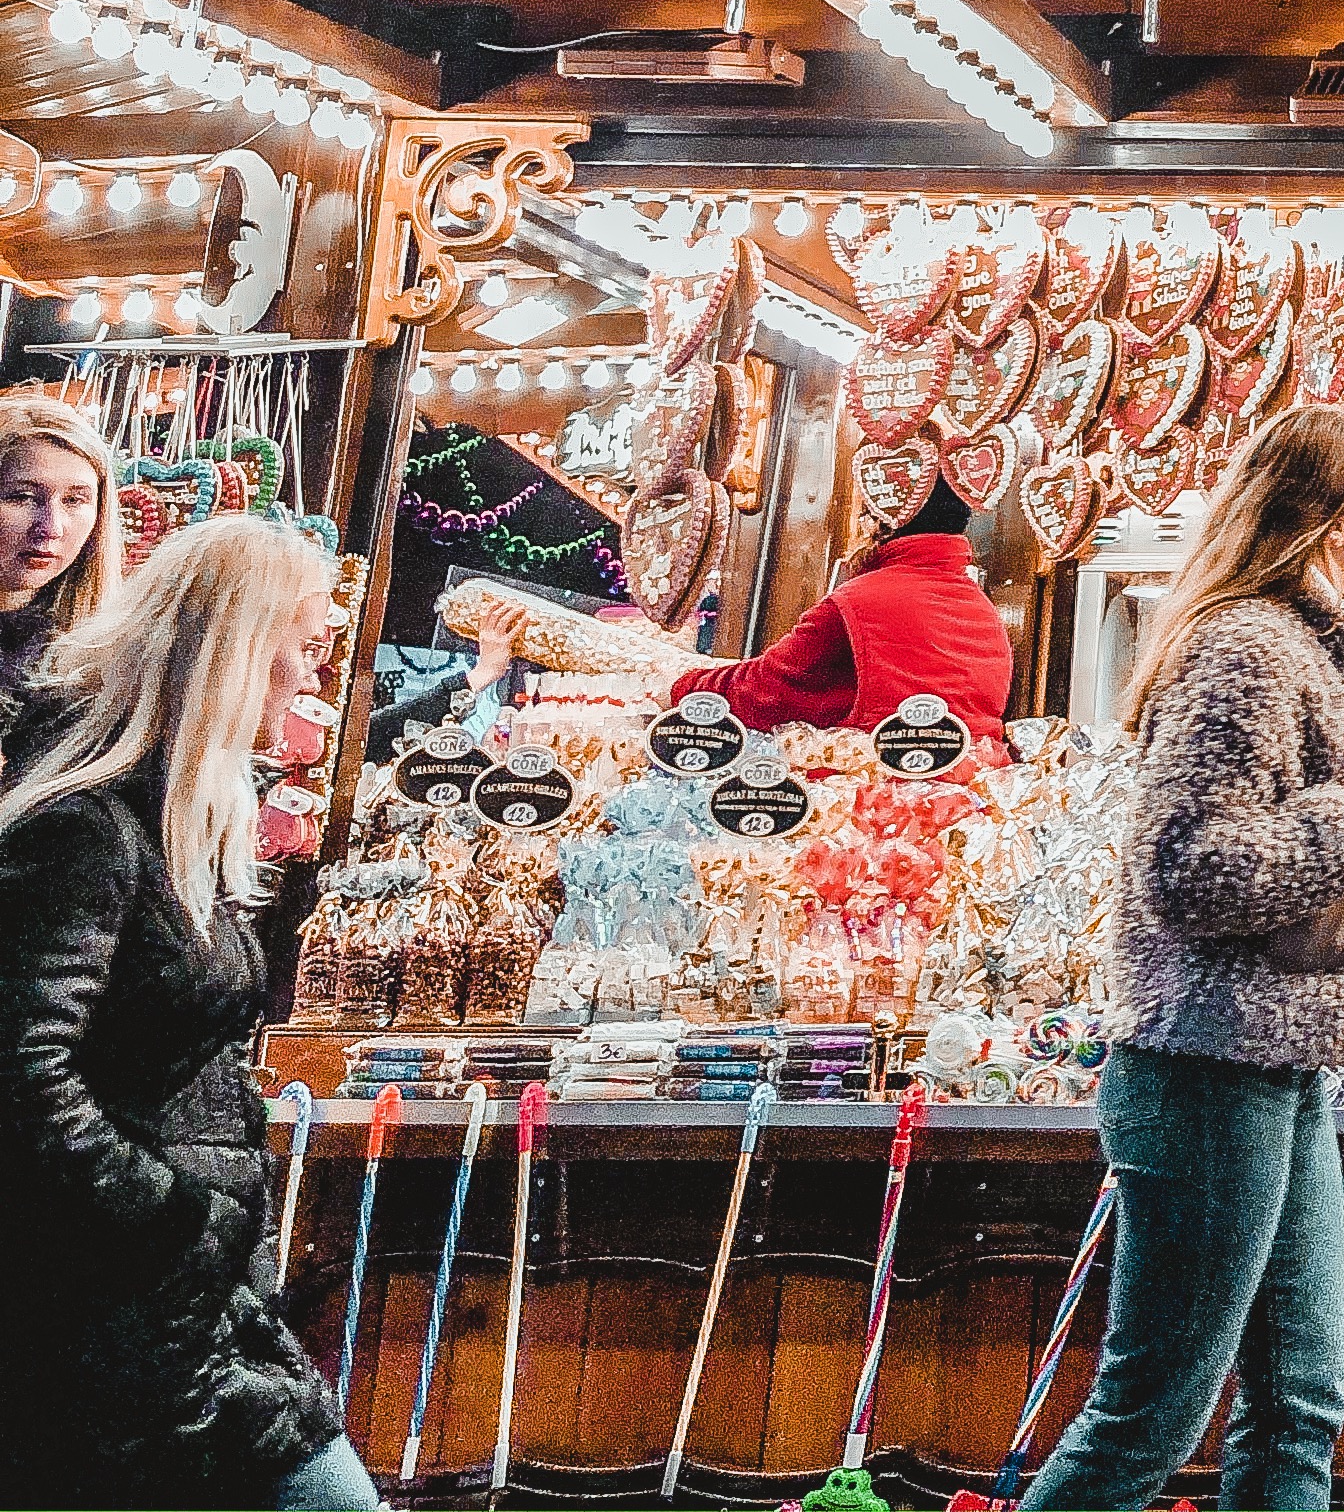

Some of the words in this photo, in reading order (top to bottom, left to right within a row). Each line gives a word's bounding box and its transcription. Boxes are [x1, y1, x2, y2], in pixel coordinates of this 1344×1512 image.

[429, 738, 468, 753] CONÉ
[511, 757, 549, 773] CONÉ
[598, 1042, 625, 1061] 3€
